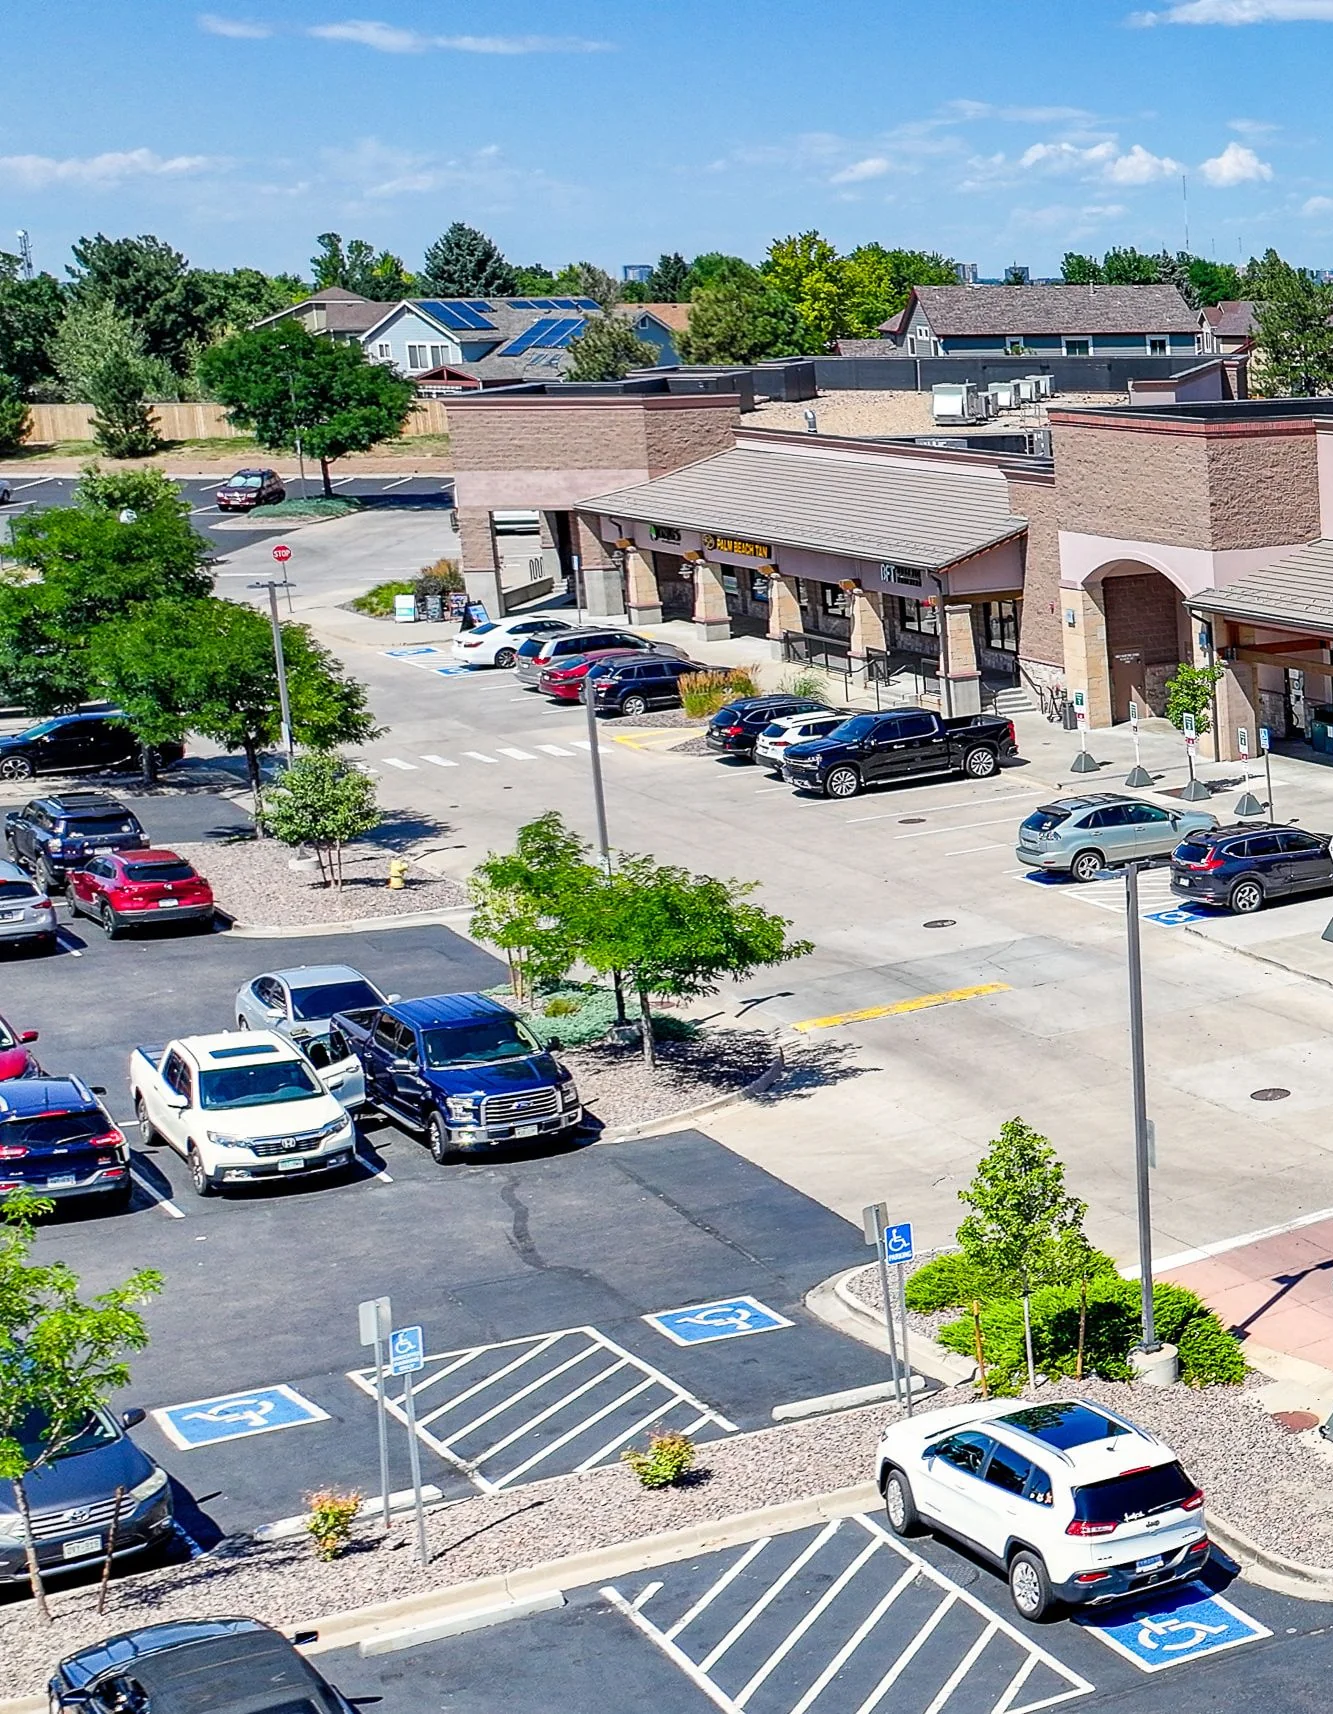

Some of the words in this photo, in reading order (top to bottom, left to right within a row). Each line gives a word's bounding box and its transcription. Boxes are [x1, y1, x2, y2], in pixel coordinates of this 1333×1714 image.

[716, 537, 733, 552] PALM
[733, 540, 755, 556] BEACH
[755, 544, 769, 558] TAN
